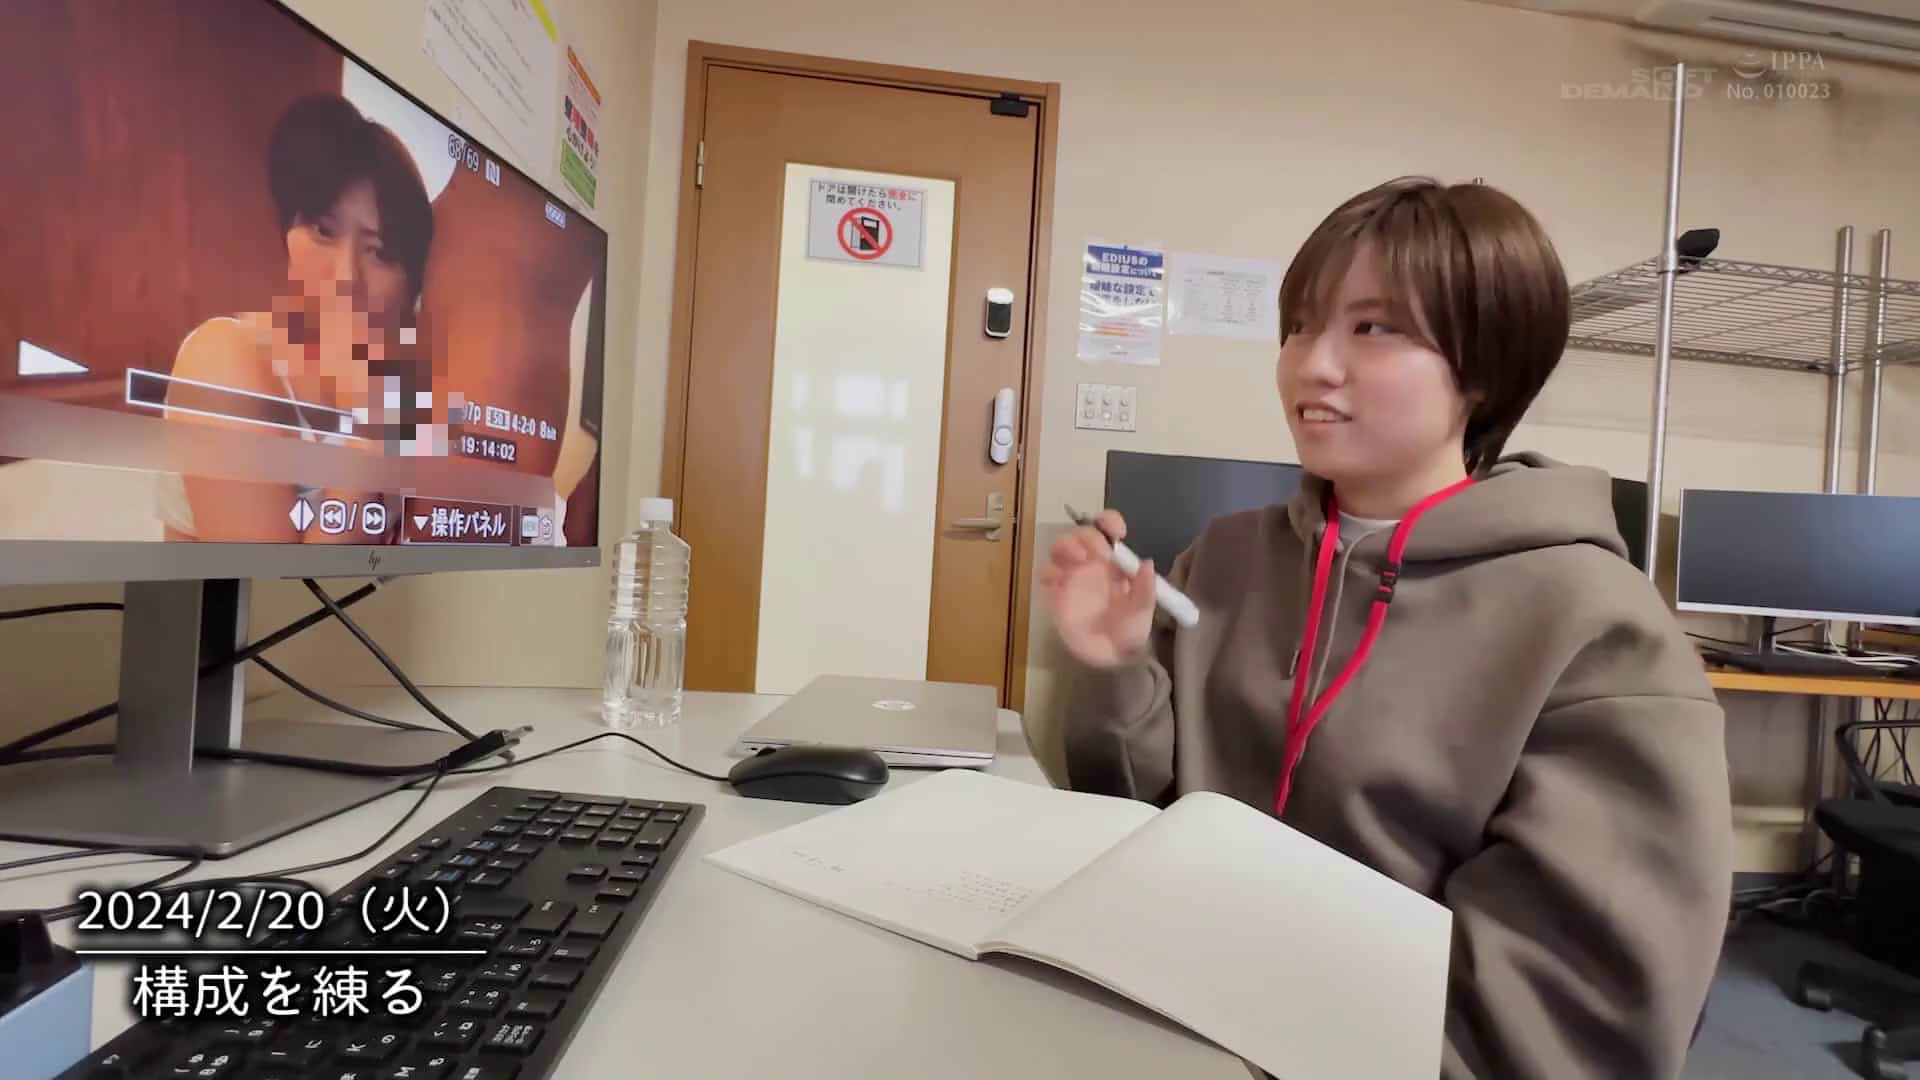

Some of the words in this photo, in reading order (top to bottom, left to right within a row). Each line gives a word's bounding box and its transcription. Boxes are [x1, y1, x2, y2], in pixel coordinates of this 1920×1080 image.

[431, 507, 507, 538] 操作パネル
